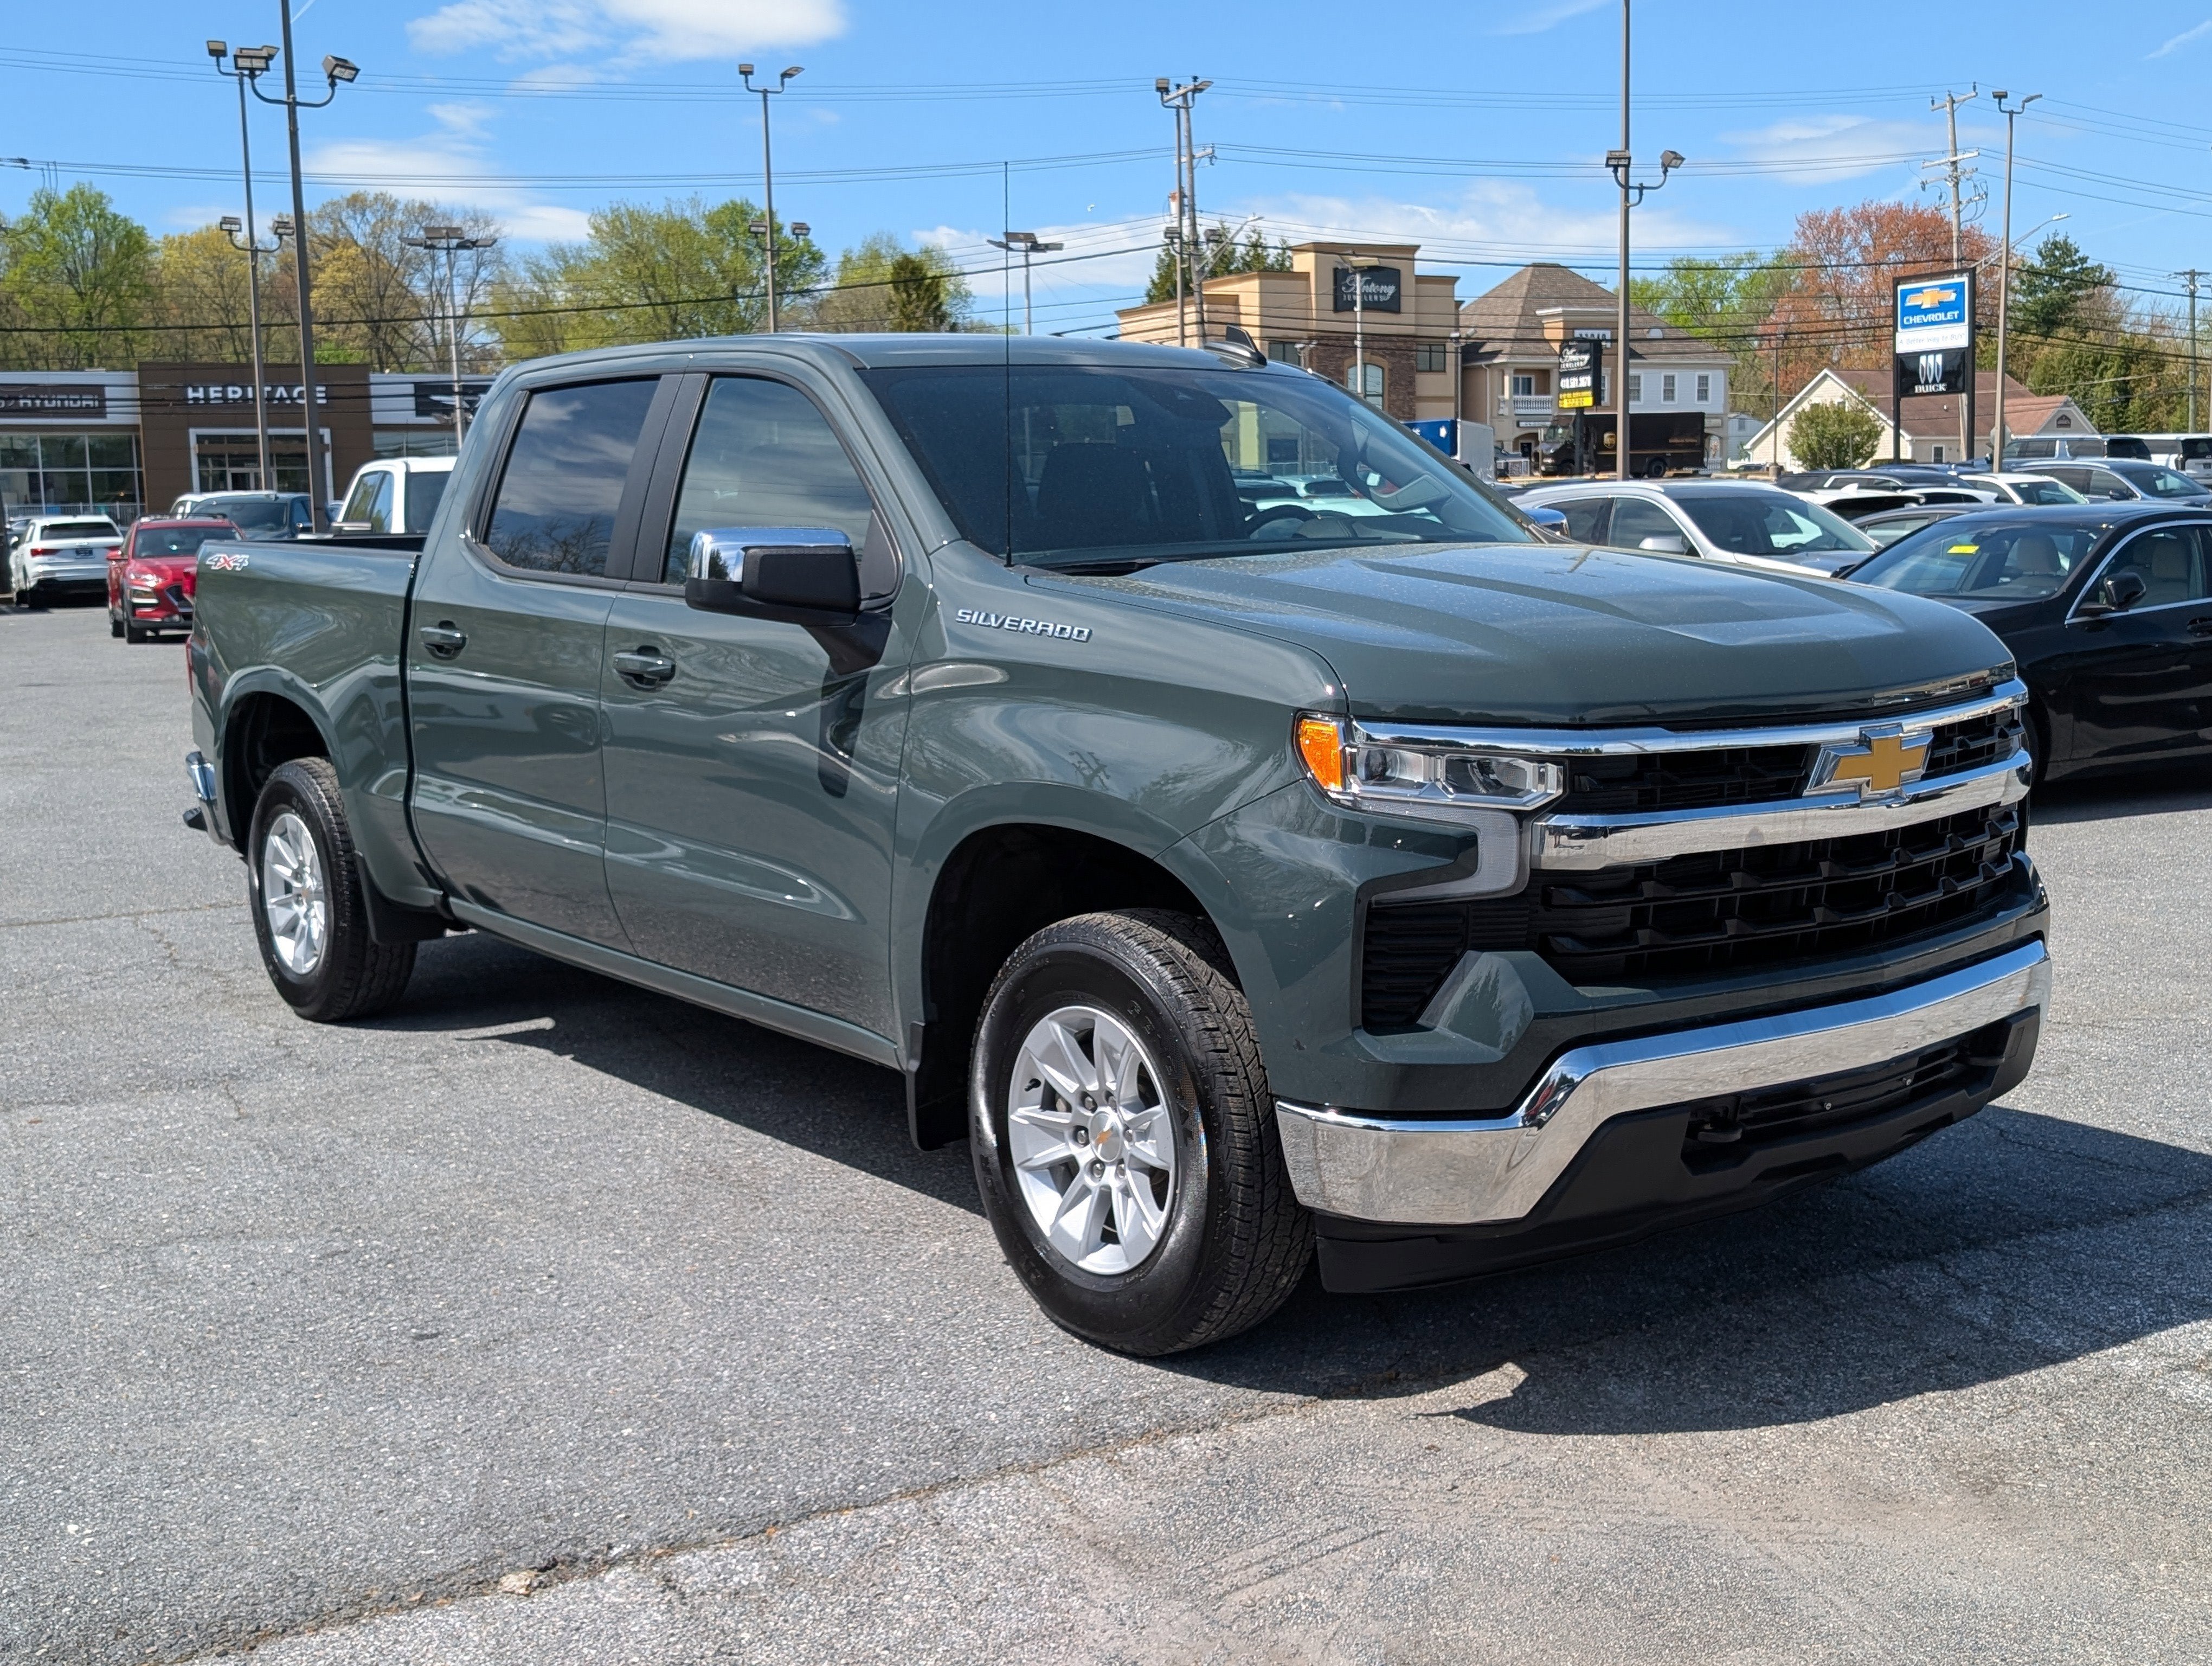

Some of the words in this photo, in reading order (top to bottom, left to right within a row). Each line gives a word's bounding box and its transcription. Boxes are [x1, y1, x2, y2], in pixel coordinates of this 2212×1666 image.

[1904, 311, 1959, 325] CHEVROLET
[1914, 382, 1948, 393] BUICK
[19, 394, 99, 407] HYUNDAI
[955, 608, 1092, 643] SILVERADO
